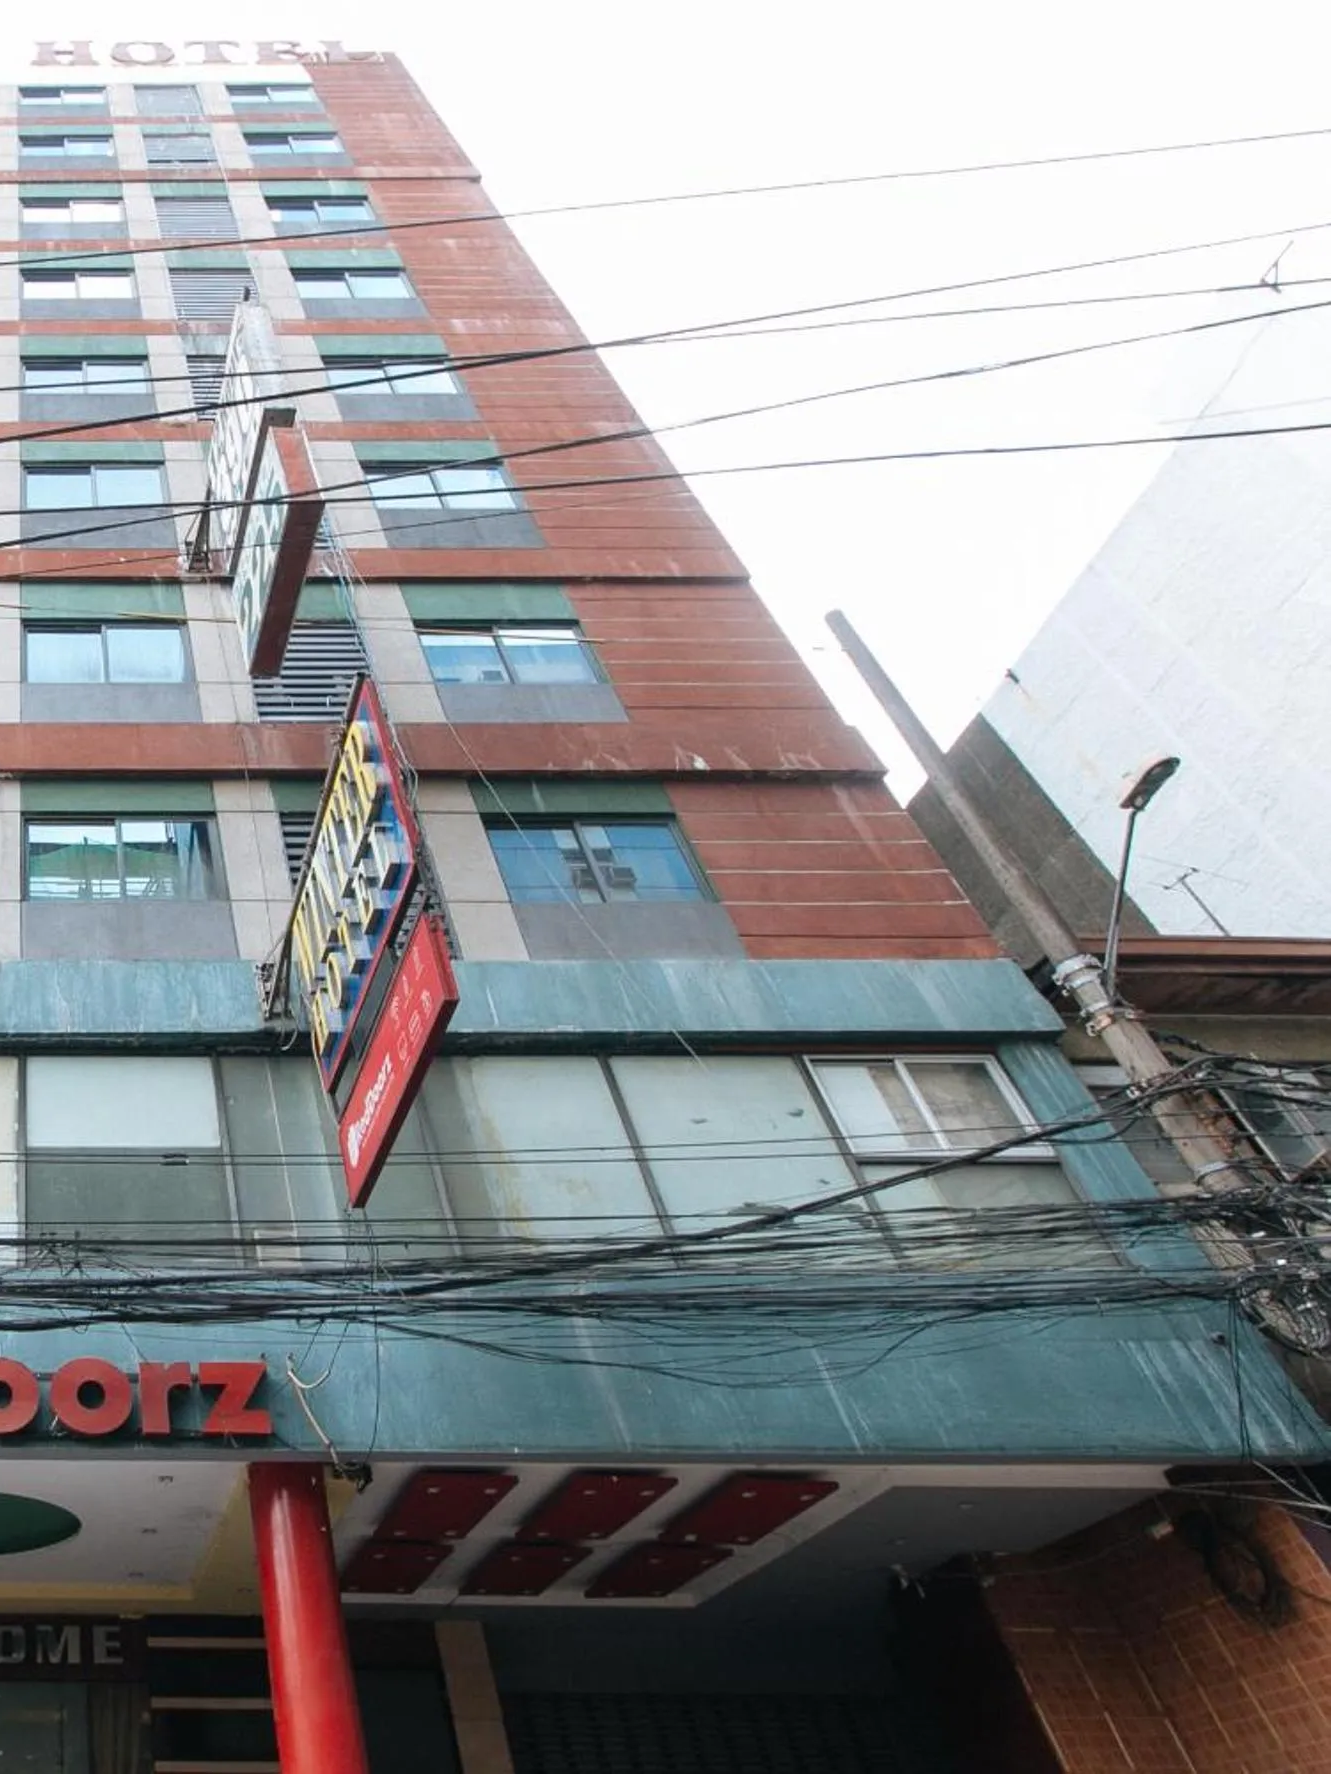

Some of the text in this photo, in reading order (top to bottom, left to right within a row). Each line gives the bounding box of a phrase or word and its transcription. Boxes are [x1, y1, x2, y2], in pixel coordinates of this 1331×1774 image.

[30, 39, 381, 66] HOTEL
[293, 722, 376, 995] WINTER
[313, 823, 391, 1057] HOTEL
